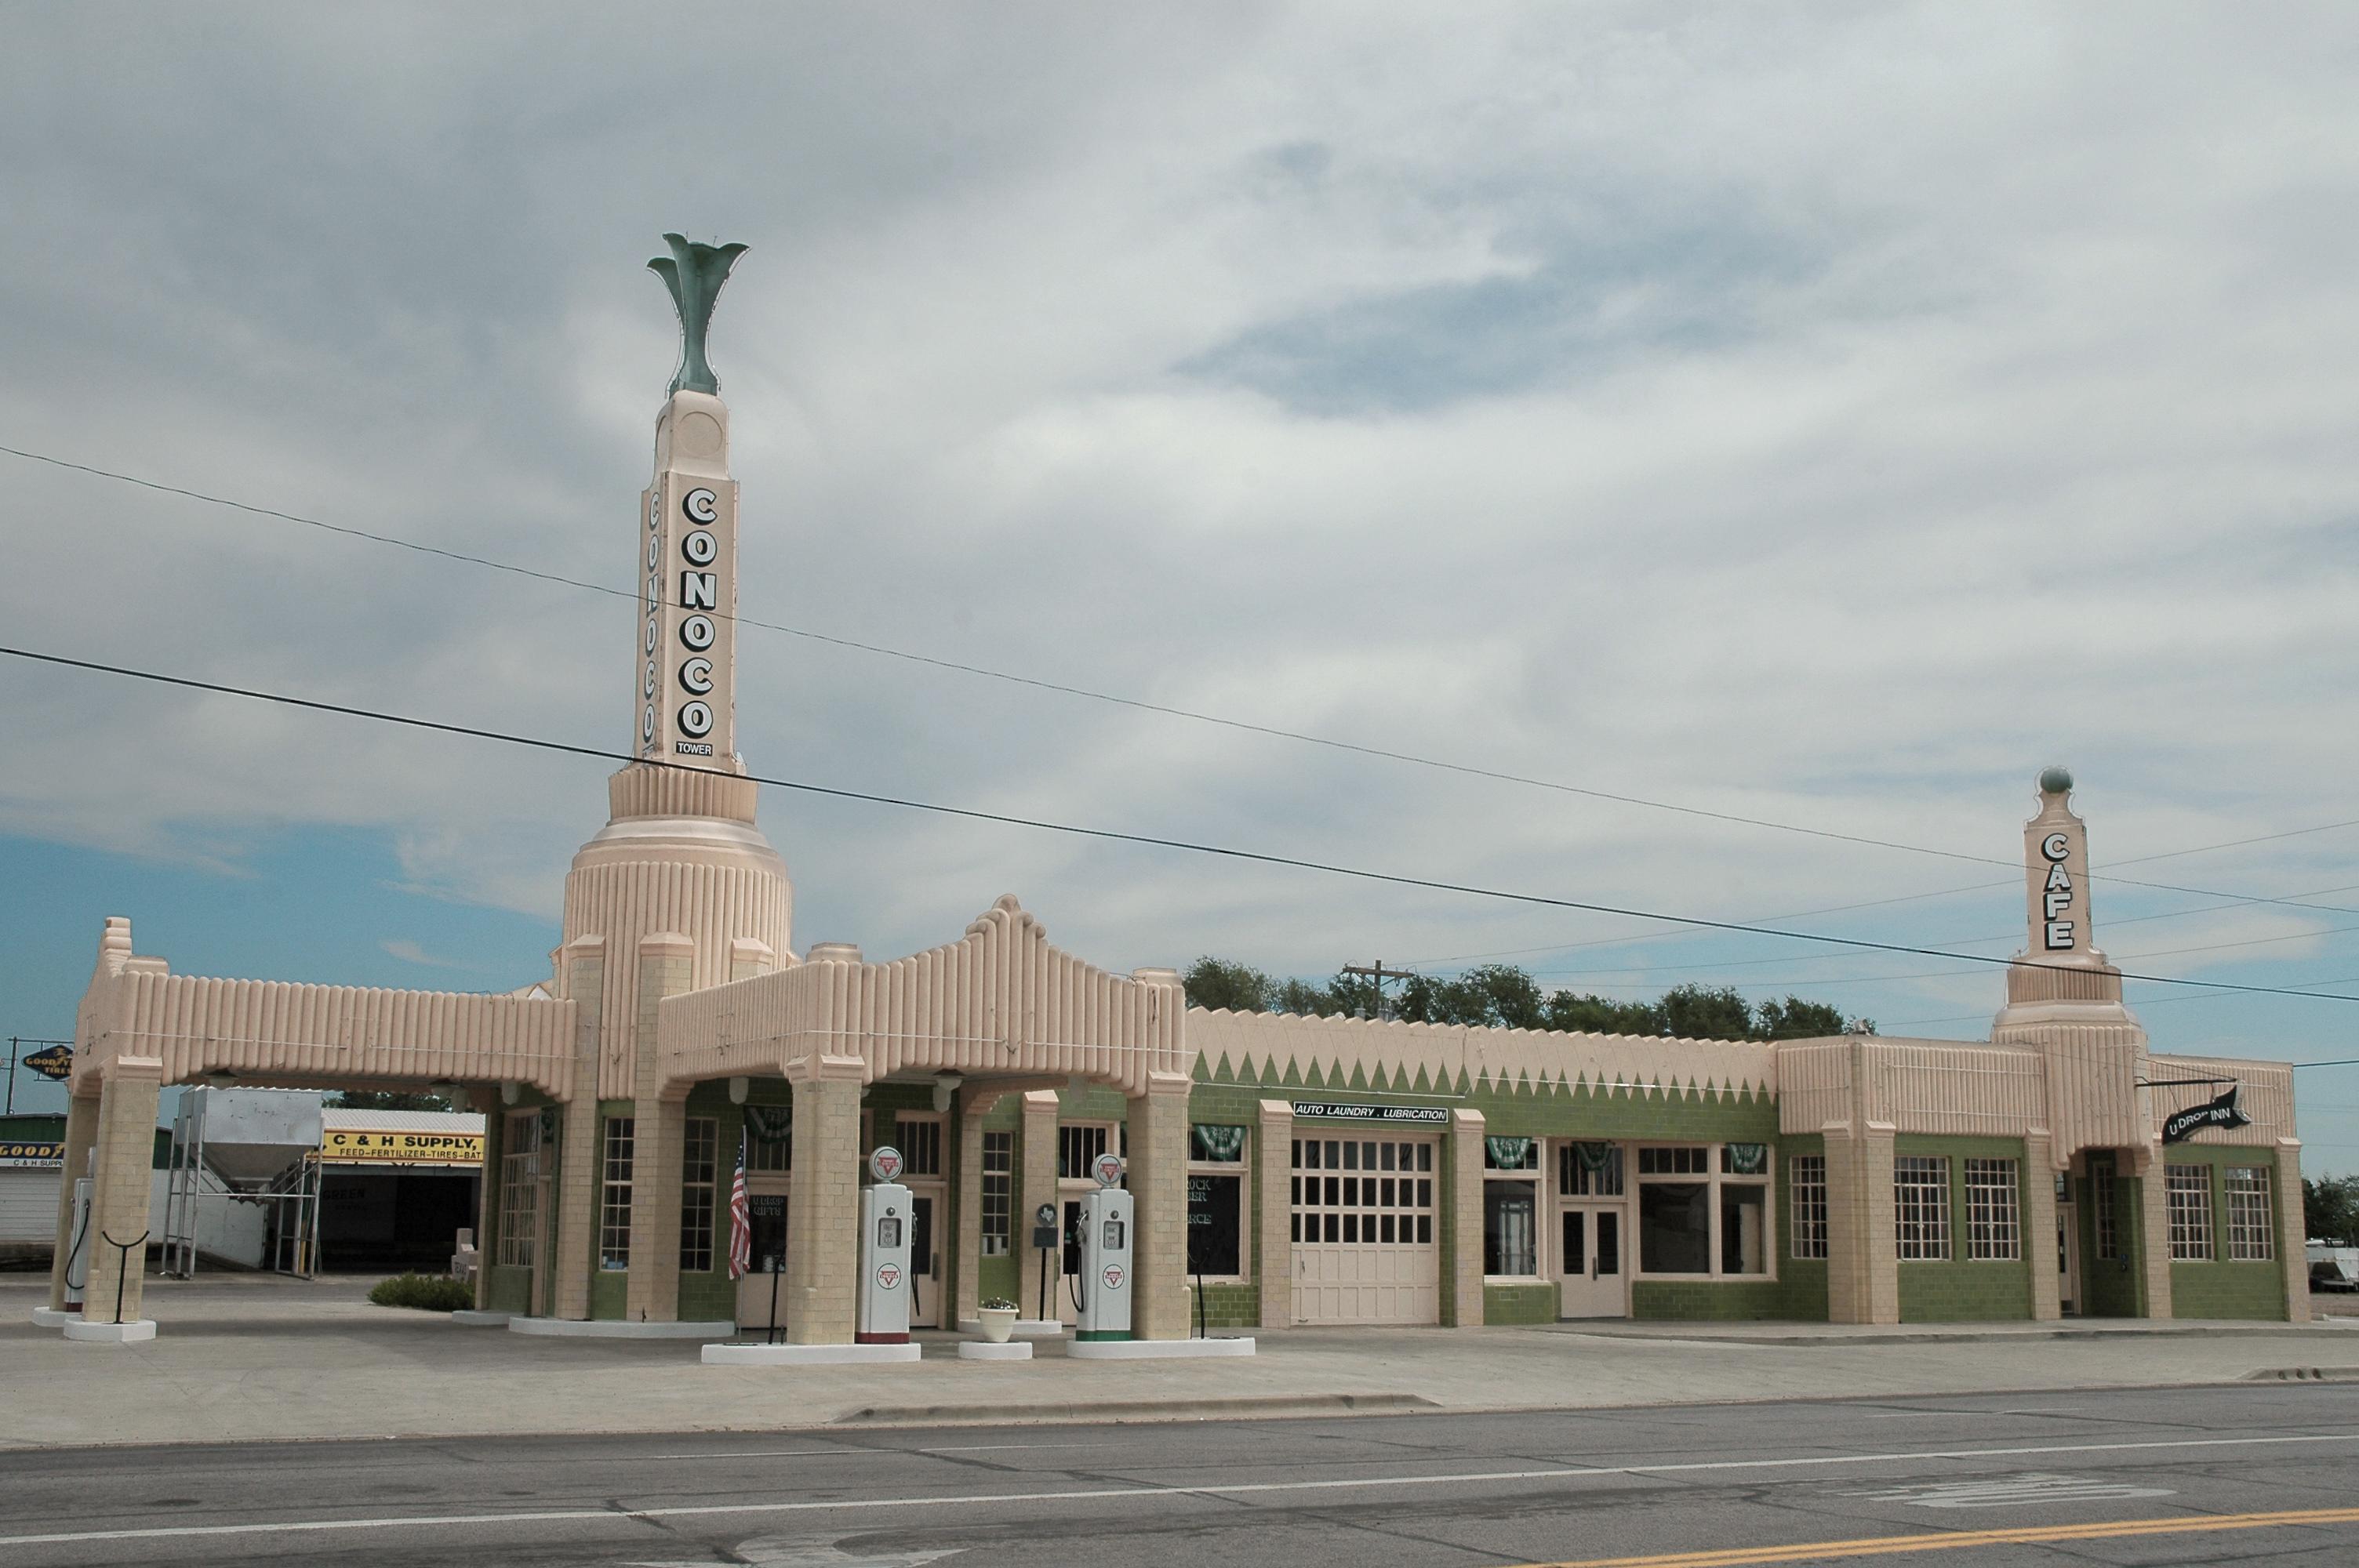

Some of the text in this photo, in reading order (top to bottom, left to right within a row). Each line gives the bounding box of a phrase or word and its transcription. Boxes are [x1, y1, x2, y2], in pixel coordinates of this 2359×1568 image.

[642, 492, 660, 744] CONOCO
[677, 487, 718, 739] CONOCO
[678, 742, 711, 755] TOWER
[2041, 833, 2074, 950] CAFE
[26, 1058, 71, 1066] GOODY
[1296, 1105, 1445, 1120] AUTO LAUNDRY LUBRICATION
[2169, 1107, 2230, 1135] U DROP INN
[333, 1134, 476, 1150] C & H SUPPLY,
[1187, 1178, 1211, 1190] OCK
[1187, 1214, 1212, 1224] RCE
